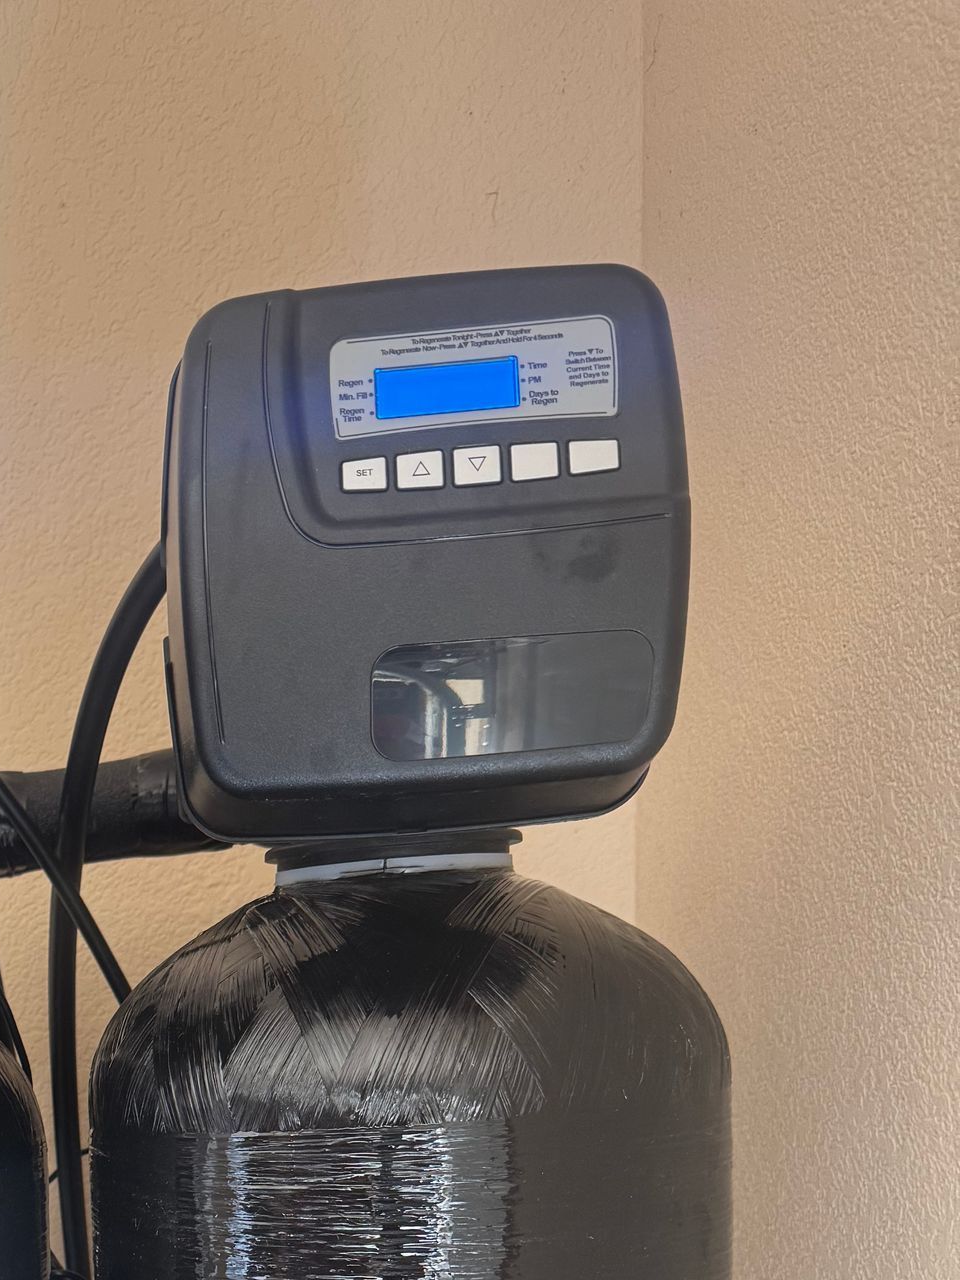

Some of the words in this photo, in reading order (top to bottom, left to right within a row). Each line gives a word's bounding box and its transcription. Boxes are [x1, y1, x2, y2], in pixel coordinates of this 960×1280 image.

[528, 362, 548, 370] Time
[338, 379, 364, 388] Regen
[528, 376, 542, 384] PM
[570, 379, 609, 387] Regenerate
[356, 392, 368, 400] Fill
[529, 390, 549, 398] Days
[531, 397, 558, 406] Regen
[339, 408, 365, 416] Regen
[342, 415, 362, 423] Time
[356, 468, 373, 477] SET
